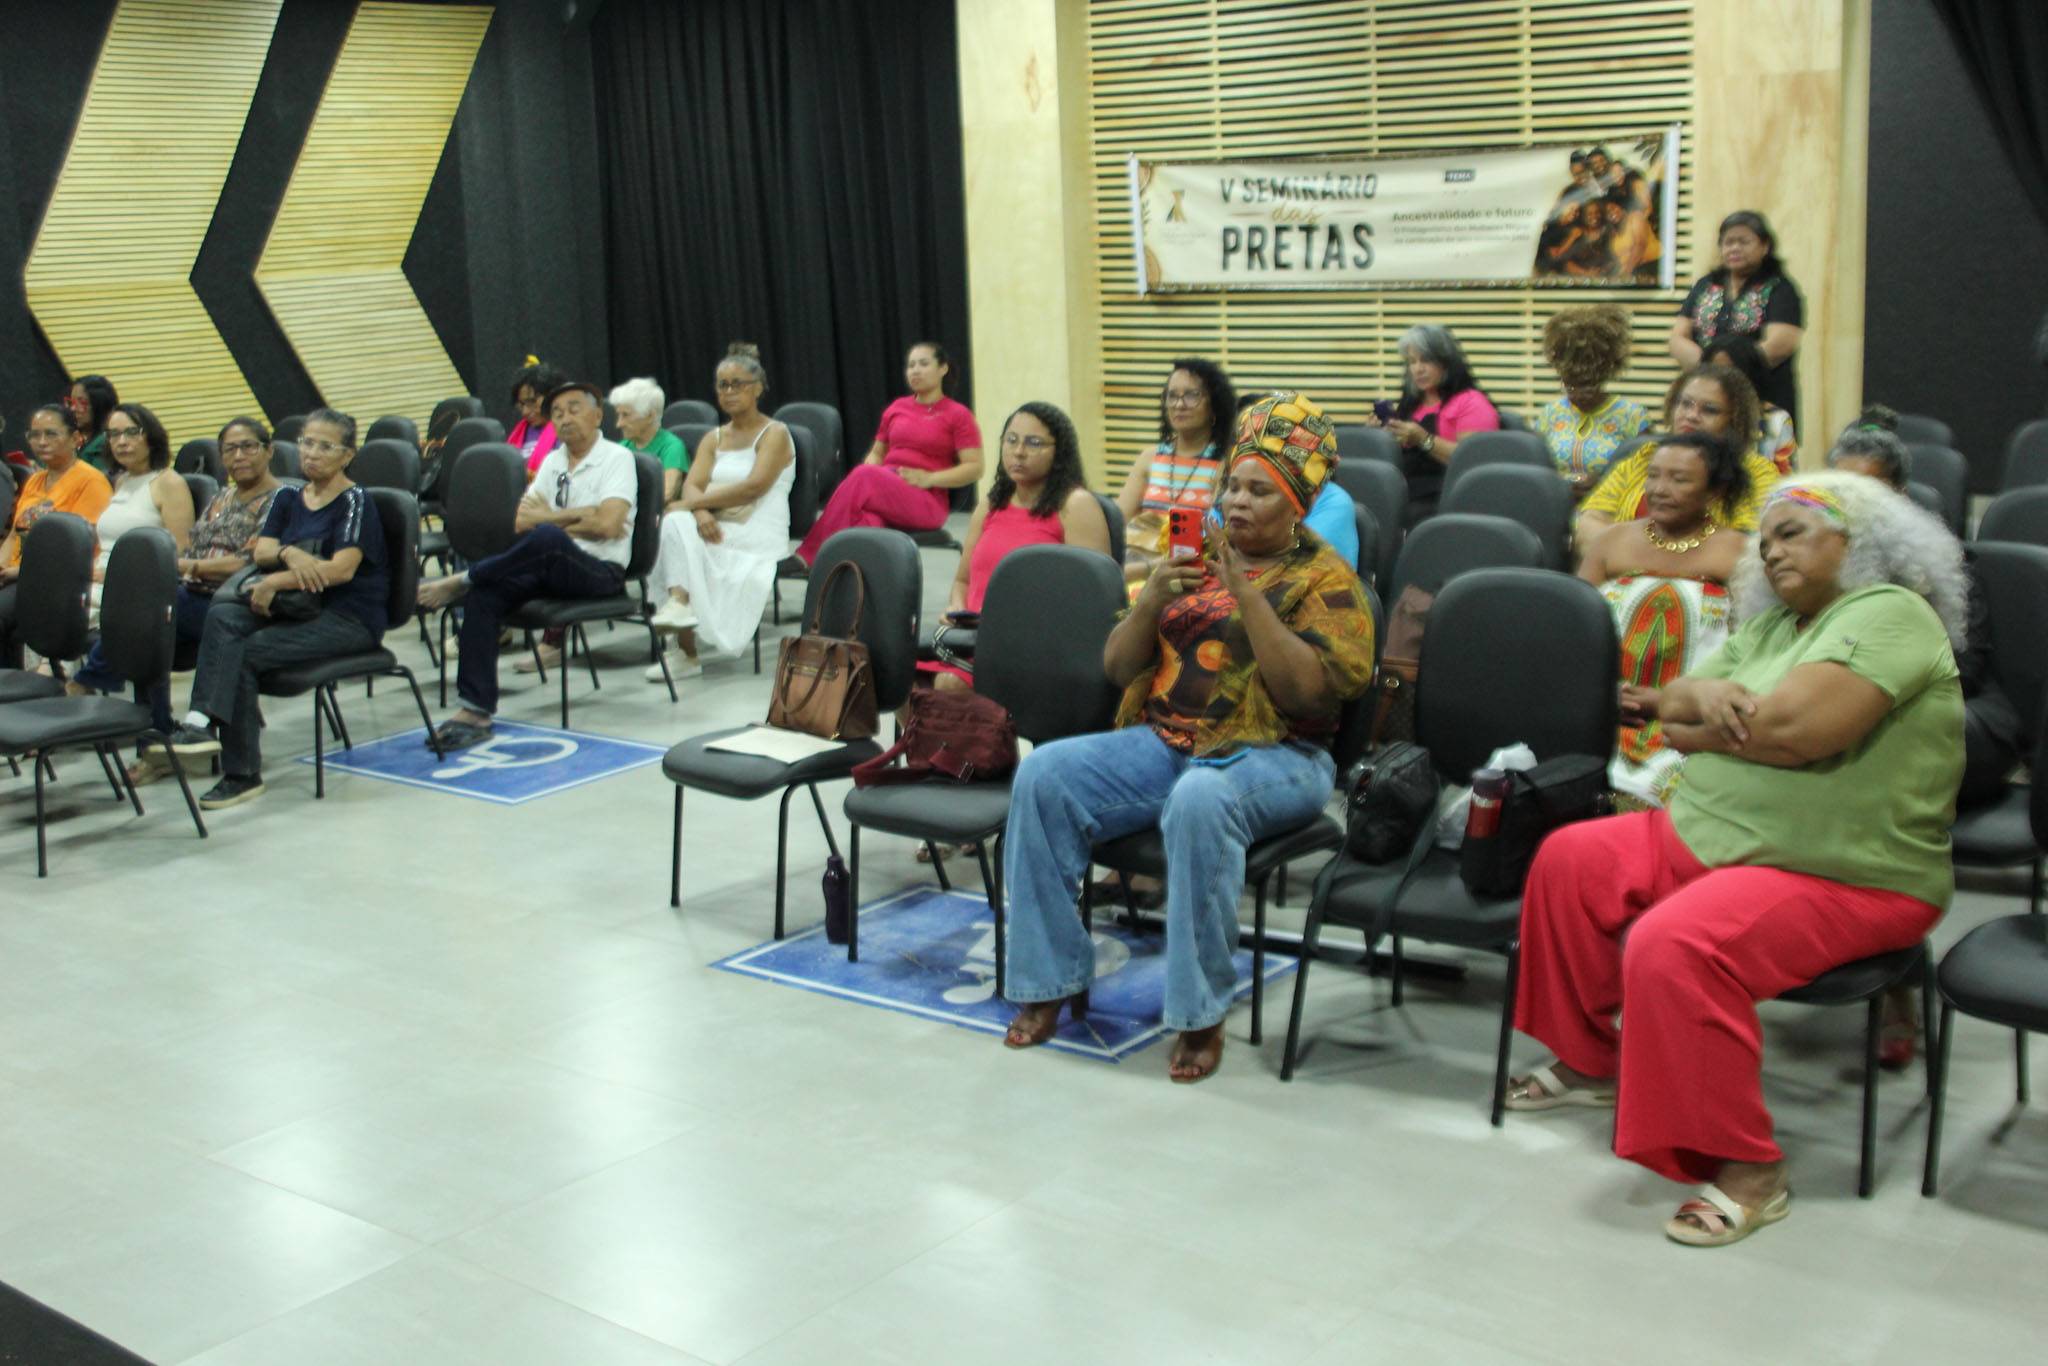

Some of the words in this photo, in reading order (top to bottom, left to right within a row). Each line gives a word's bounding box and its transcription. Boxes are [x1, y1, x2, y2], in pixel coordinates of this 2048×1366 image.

[1221, 178, 1234, 203] V
[1242, 171, 1378, 203] SEMINÁRIO
[1271, 202, 1323, 224] das
[1393, 208, 1482, 222] Ancestralidade
[1222, 222, 1375, 271] PRETAS
